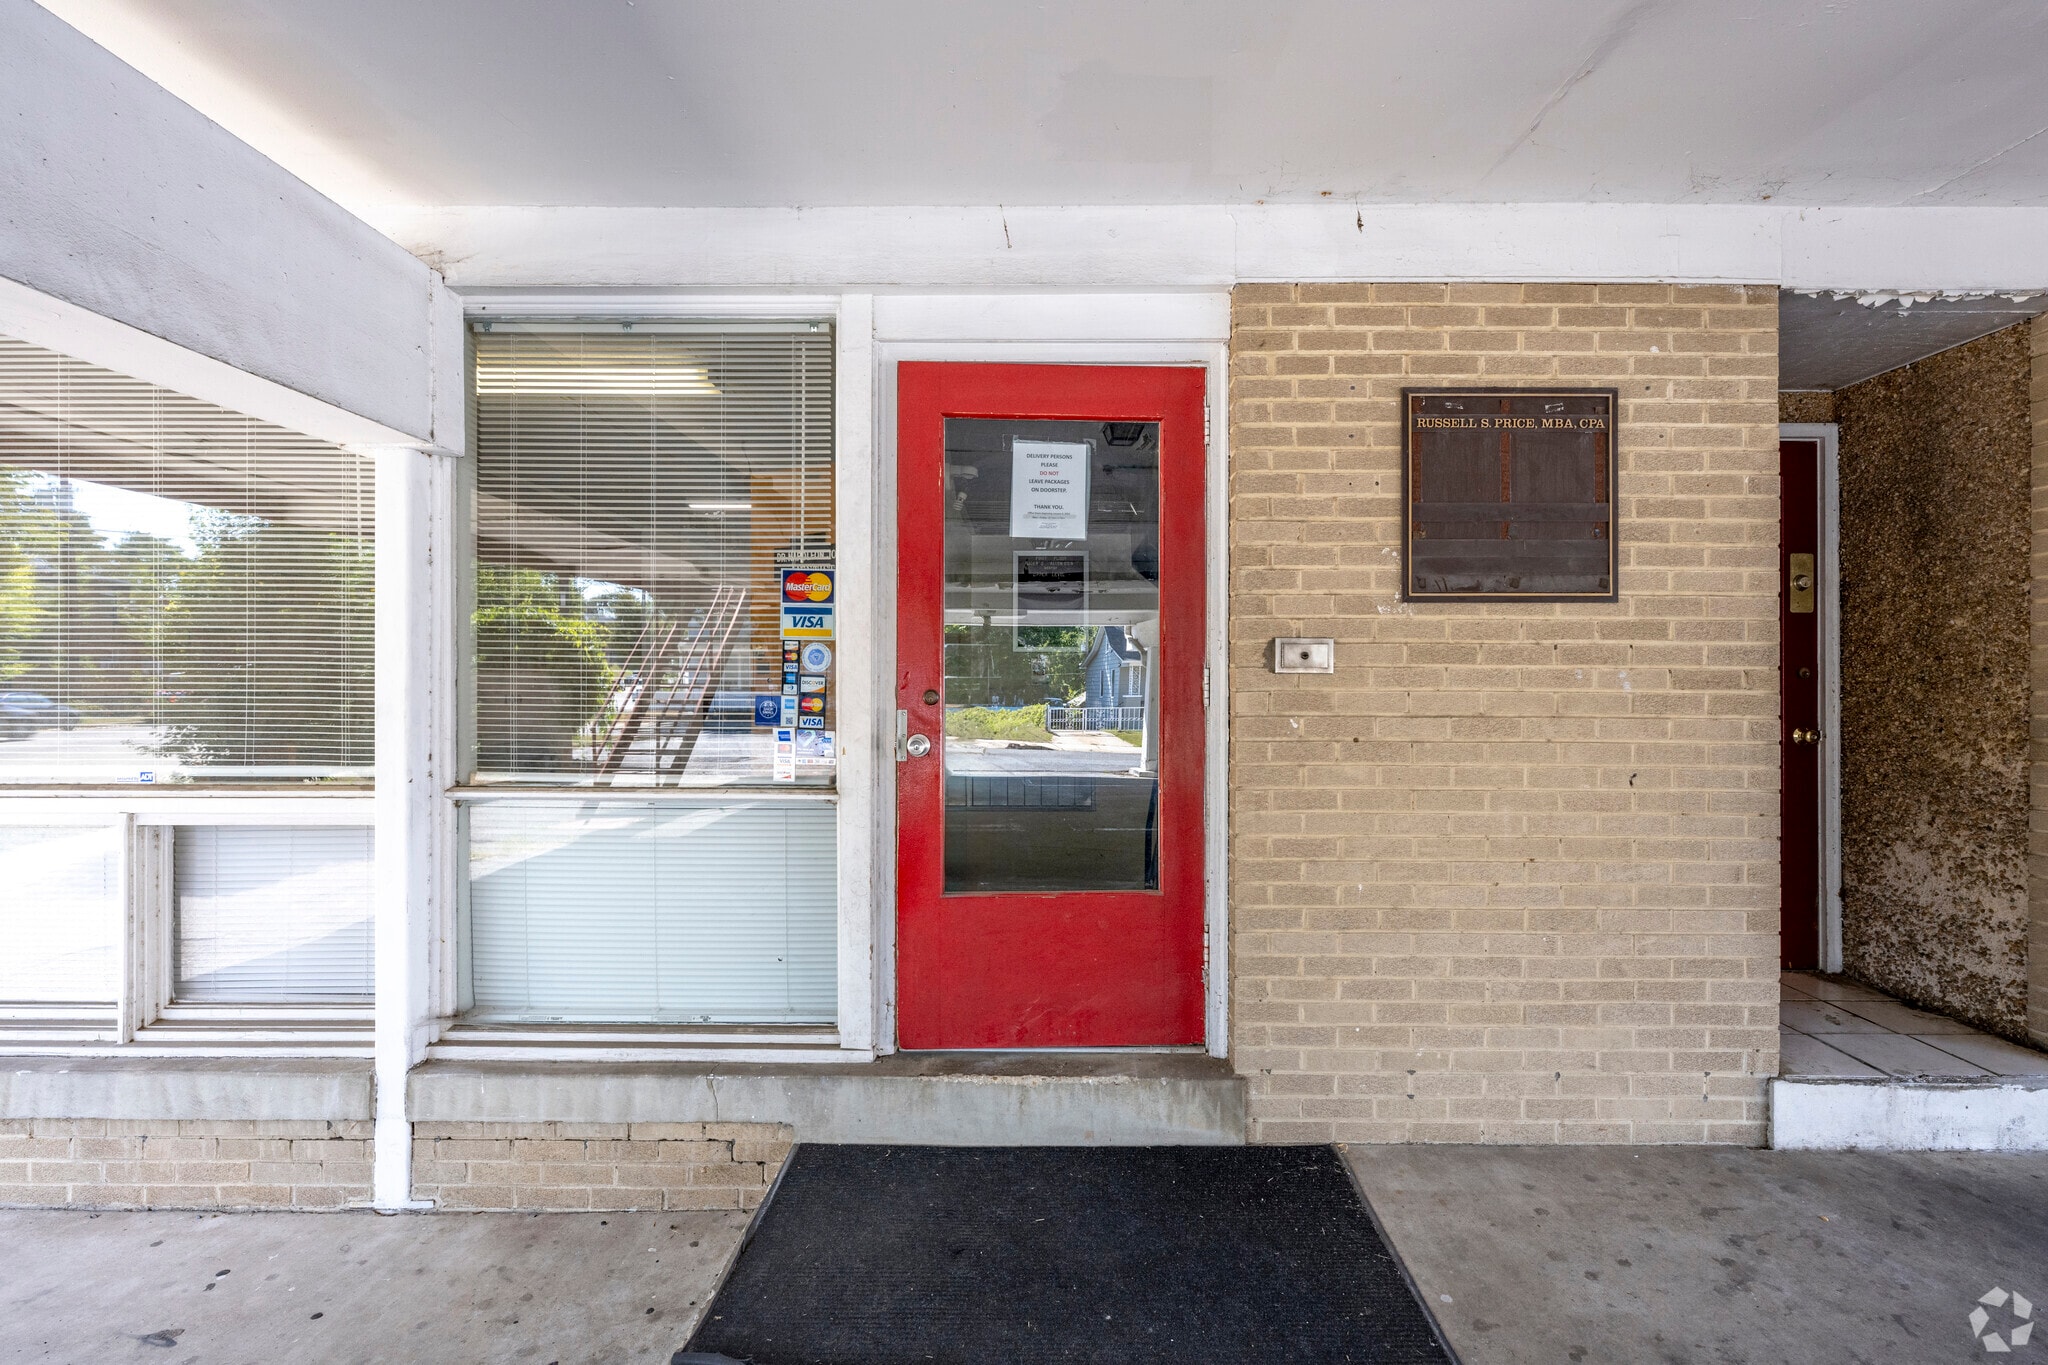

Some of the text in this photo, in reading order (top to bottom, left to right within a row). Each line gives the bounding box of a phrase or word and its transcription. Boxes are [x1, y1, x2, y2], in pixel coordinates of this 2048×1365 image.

[1416, 417, 1606, 429] RUSSELL S. PRICE, MBA, CPA
[785, 582, 831, 592] MasterCard
[791, 615, 824, 628] VISA
[802, 717, 823, 726] VISA
[140, 772, 153, 781] ADT
